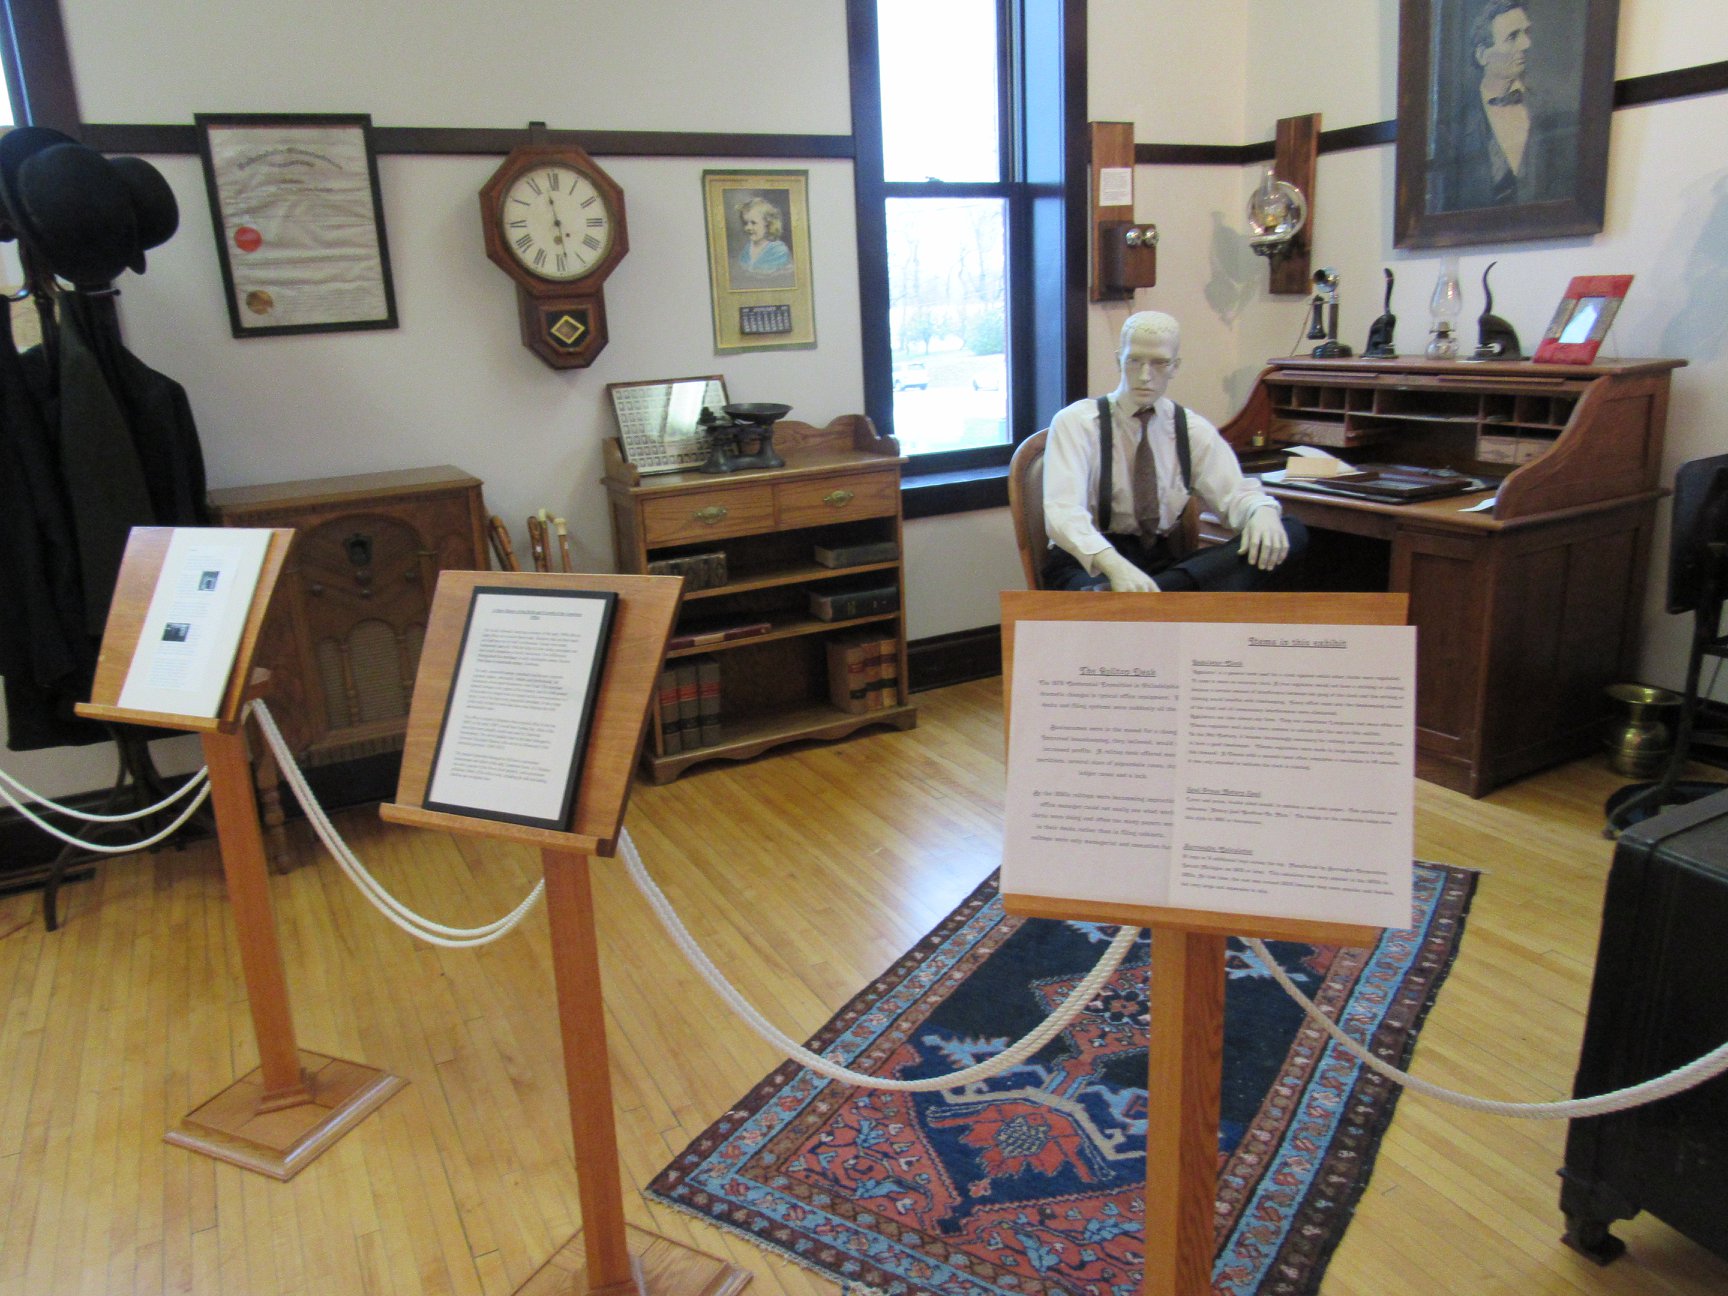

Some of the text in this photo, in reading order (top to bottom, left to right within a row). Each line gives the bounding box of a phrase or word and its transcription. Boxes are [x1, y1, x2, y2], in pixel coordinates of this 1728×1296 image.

[580, 195, 596, 209] II
[586, 218, 603, 227] III
[1079, 666, 1096, 675] The
[1133, 667, 1156, 676] Desk
